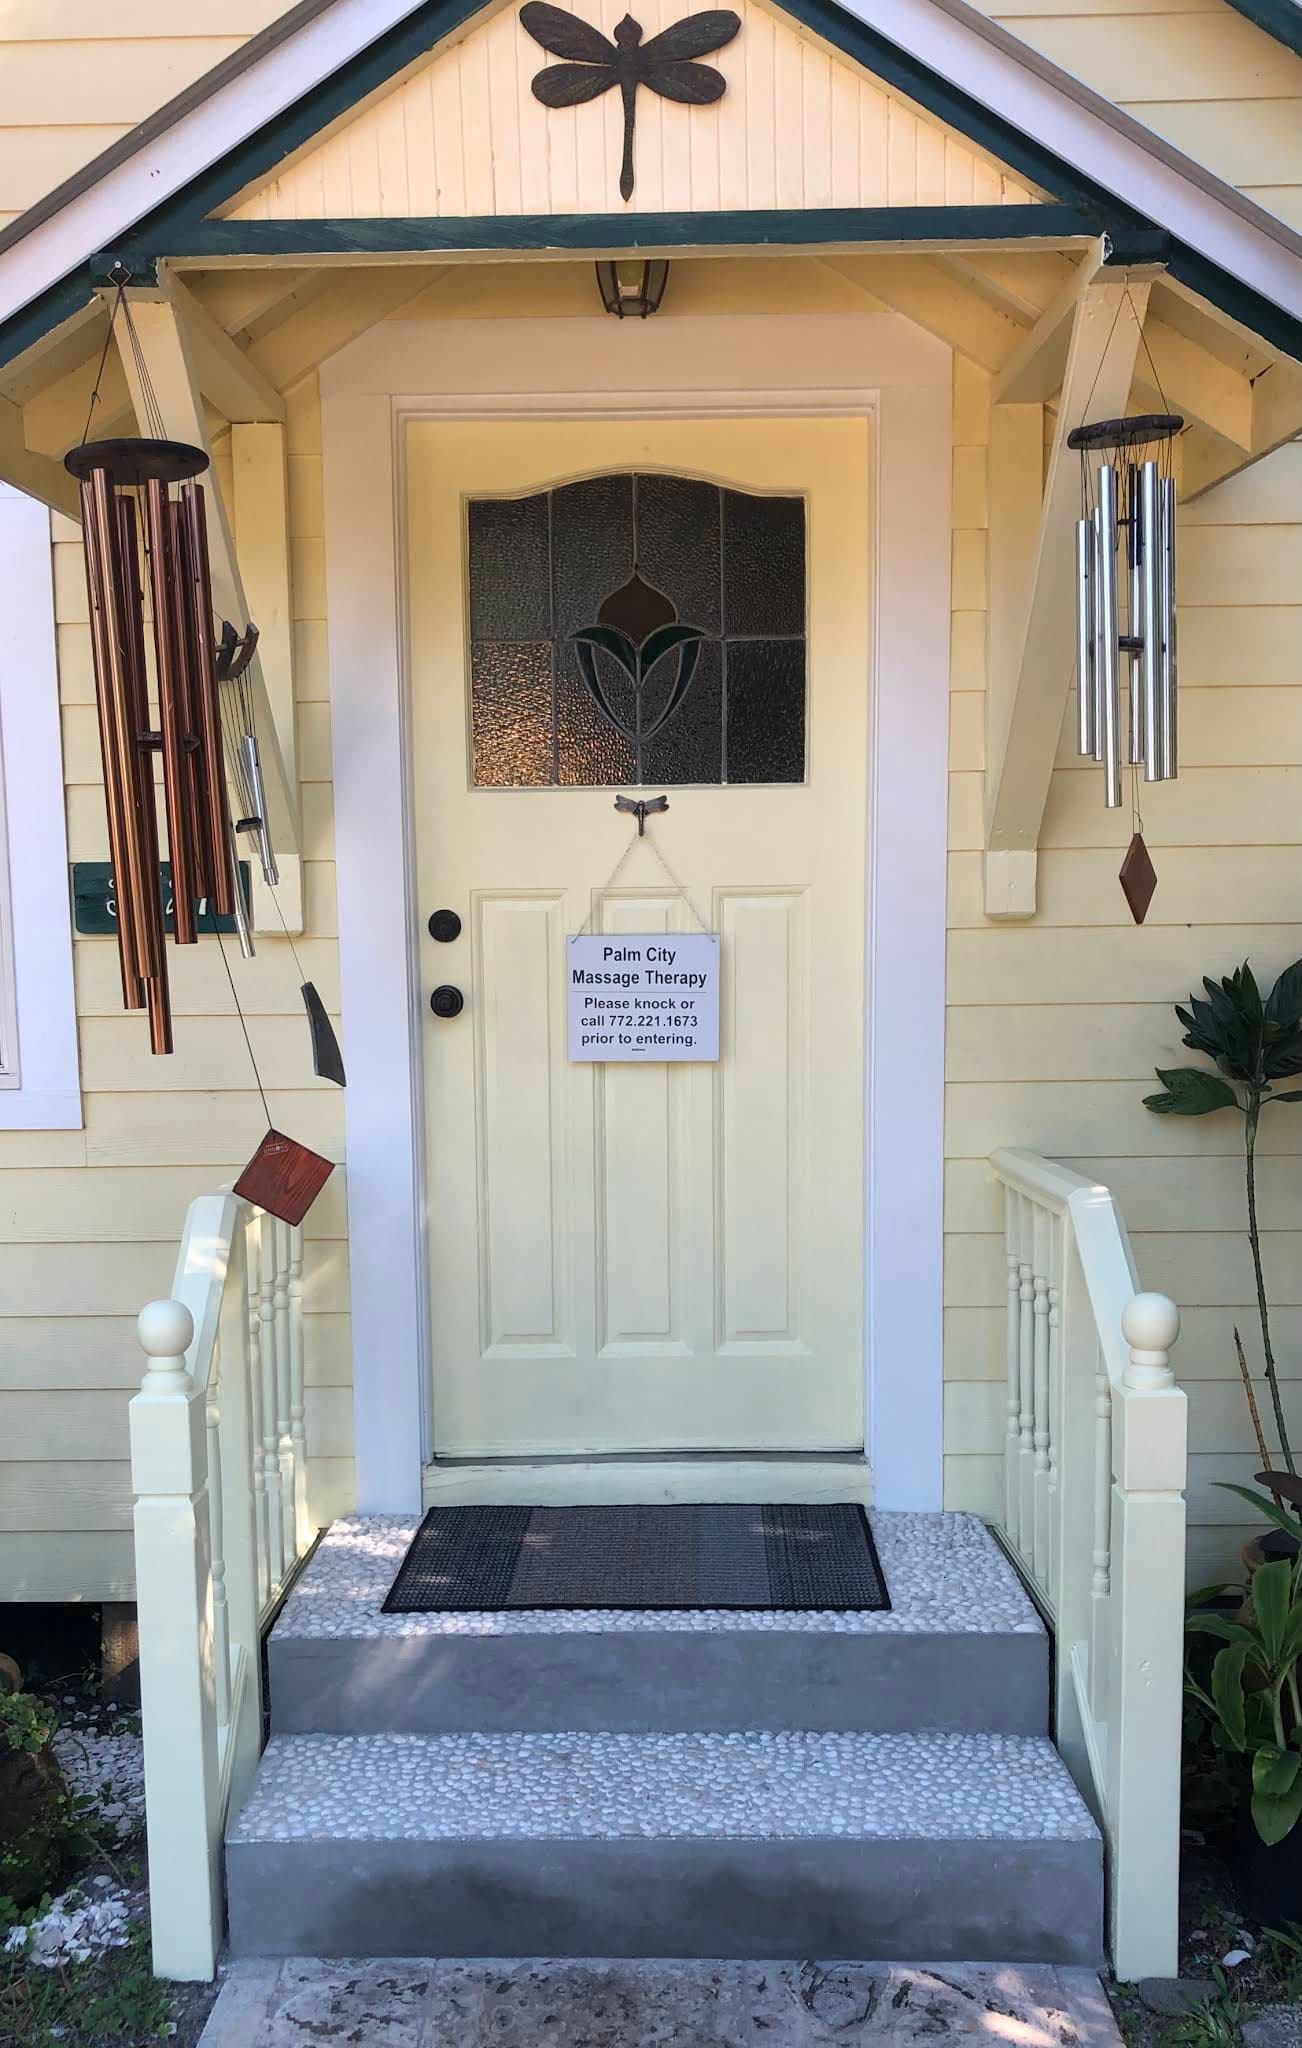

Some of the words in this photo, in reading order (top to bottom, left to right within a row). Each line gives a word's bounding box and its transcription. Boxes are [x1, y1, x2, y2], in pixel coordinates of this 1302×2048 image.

[603, 946, 641, 961] Palm
[646, 946, 677, 965] City
[572, 969, 640, 988] Massage
[645, 970, 708, 988] Therapy
[584, 997, 630, 1009] Please
[634, 998, 676, 1009] knock
[680, 1000, 696, 1009] or
[581, 1015, 605, 1027] call
[609, 1015, 698, 1027] 772.221.1673
[581, 1032, 614, 1046] prior
[618, 1033, 632, 1044] to
[636, 1033, 697, 1047] entering.
